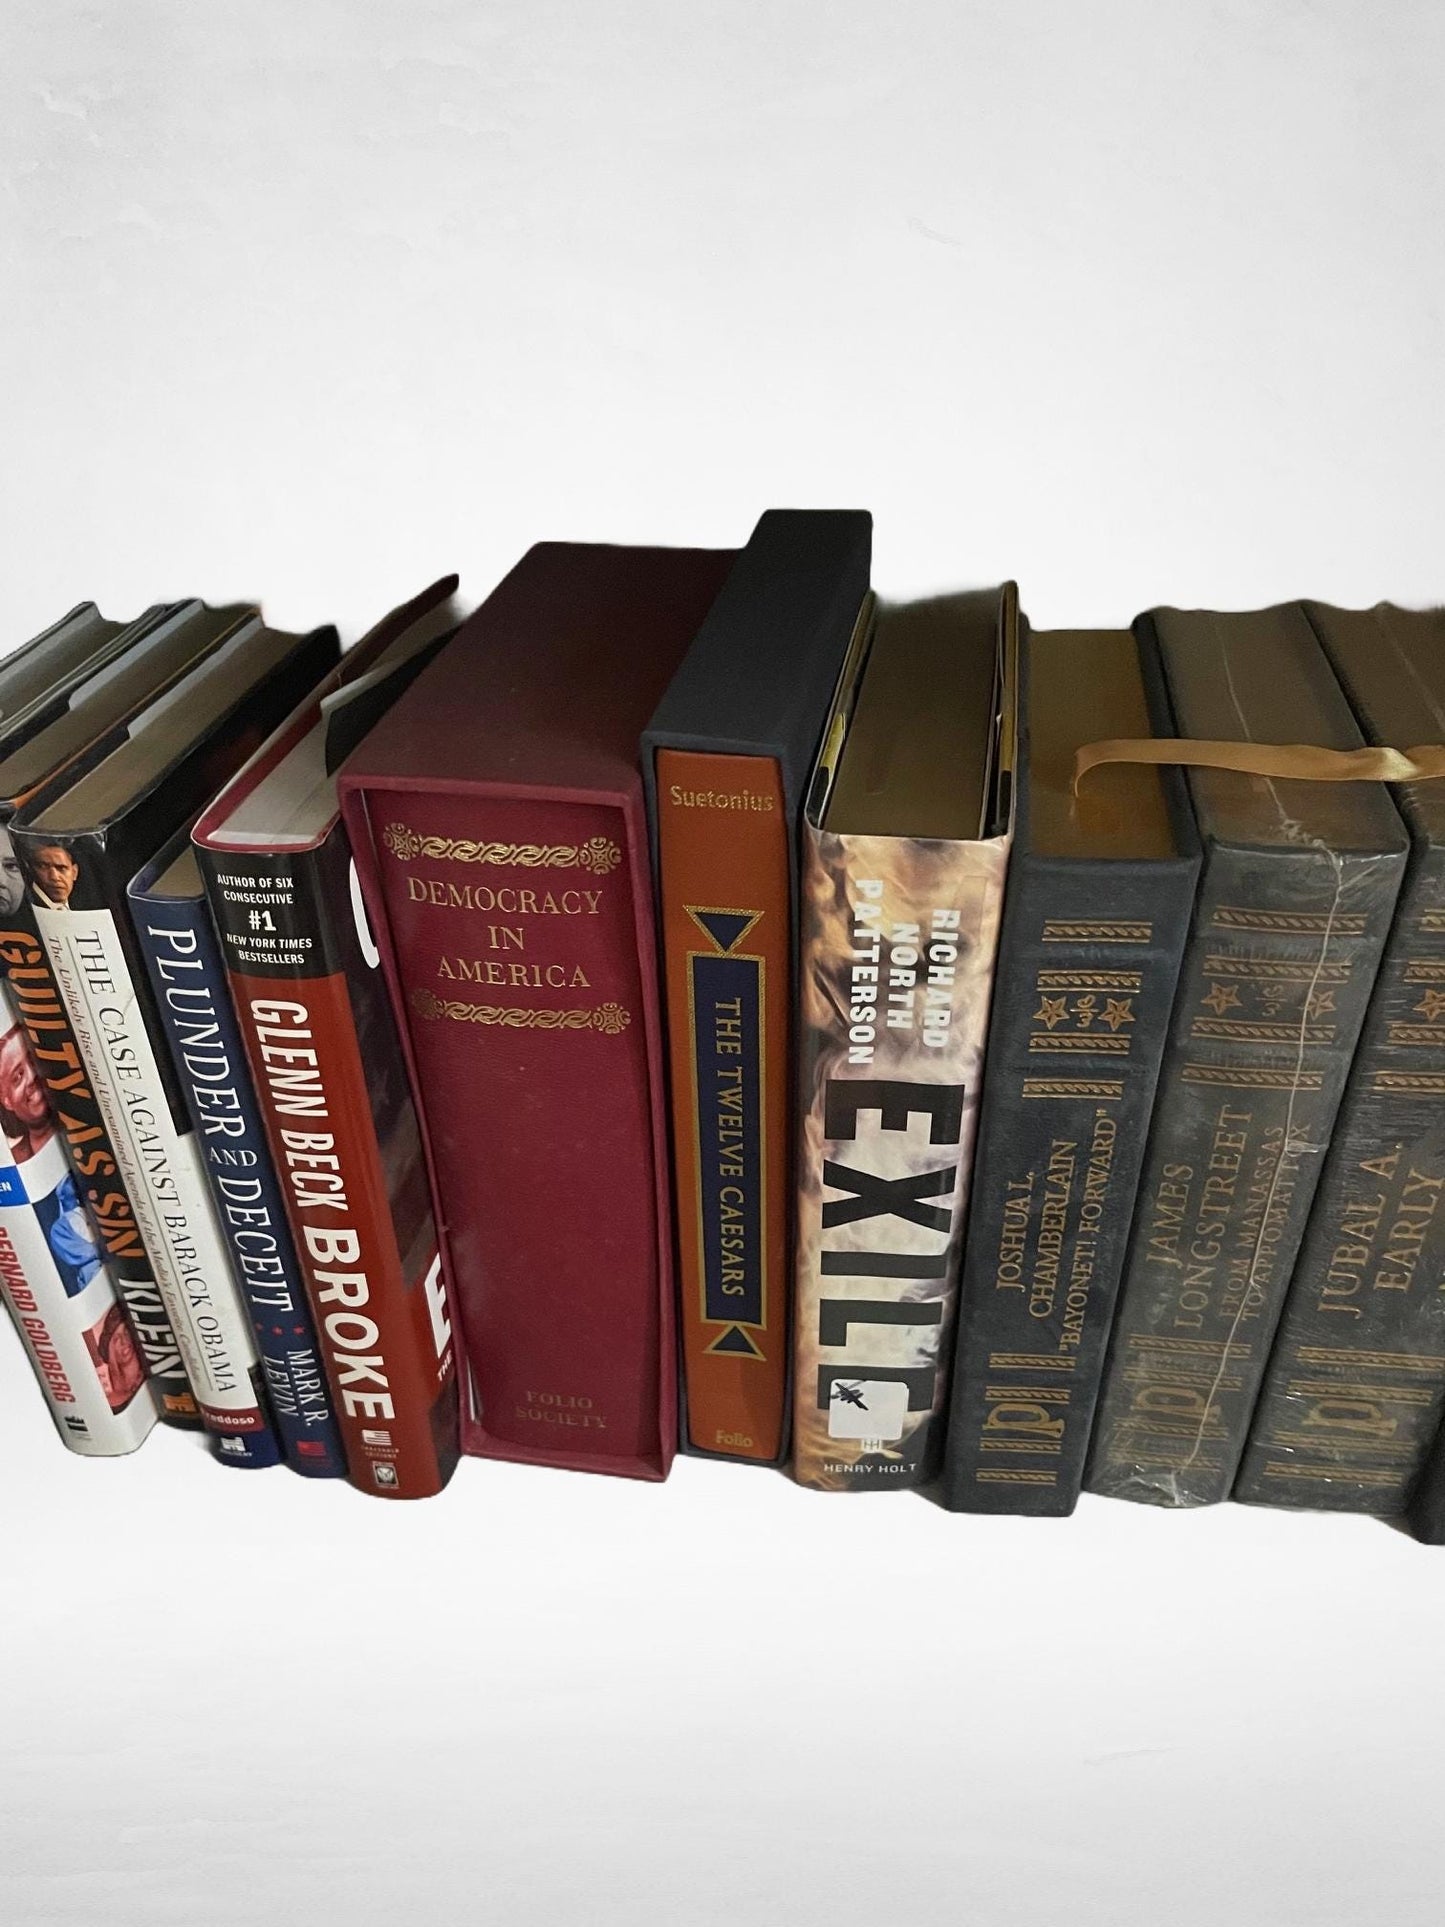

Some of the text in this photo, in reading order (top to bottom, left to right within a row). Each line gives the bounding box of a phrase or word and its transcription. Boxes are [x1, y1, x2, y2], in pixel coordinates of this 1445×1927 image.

[670, 785, 774, 811] Suetonius
[217, 873, 294, 889] AUTHOR OF SIX
[223, 890, 293, 904] CONSECUTIVE
[248, 910, 277, 931] #1
[407, 876, 603, 915] DEMOCRACY
[226, 933, 312, 949] NEW YORK TIMES
[238, 949, 305, 964] BESTSELLERS
[437, 956, 591, 988] AMERICA
[488, 925, 525, 950] IN
[848, 879, 884, 1064] PATTERSON
[887, 923, 920, 1029] NORTH
[923, 909, 961, 1048] RICHARD
[48, 936, 62, 963] The
[59, 967, 85, 1027] Unlikely
[79, 1029, 94, 1058] Rise
[88, 1060, 107, 1087] and
[0, 931, 146, 1257] GUILTY AS SIN
[148, 925, 294, 1312] PLUNDER AND DECEIT
[250, 999, 349, 1211] GLENN BECK
[715, 997, 745, 1296] THE TWELVE CAESARS
[75, 930, 238, 1392] THE CASE AGAINST BARACK OBAMA
[1079, 1108, 1117, 1232] FORWARD"
[997, 1171, 1036, 1292] JOSHUA L.
[1029, 1139, 1077, 1319] CHAMBERLAIN
[1146, 1162, 1194, 1269] JAMES
[1174, 1104, 1252, 1328] LONGSTREET
[1219, 1126, 1284, 1317] FROM MANASSAS
[1317, 1193, 1386, 1320] JUBAL
[1373, 1168, 1445, 1292] EARLY
[22, 1317, 76, 1403] GOLDBERG
[119, 1278, 188, 1378] KLEIN
[303, 1225, 396, 1420] BROKE
[263, 1354, 299, 1416] LEVIN
[286, 1349, 329, 1427] MARK R.
[516, 1406, 606, 1428] SOCIETY
[526, 1390, 593, 1409] FOLIO
[715, 1430, 753, 1447] Folio
[823, 1462, 916, 1473] HENRY HOLT
